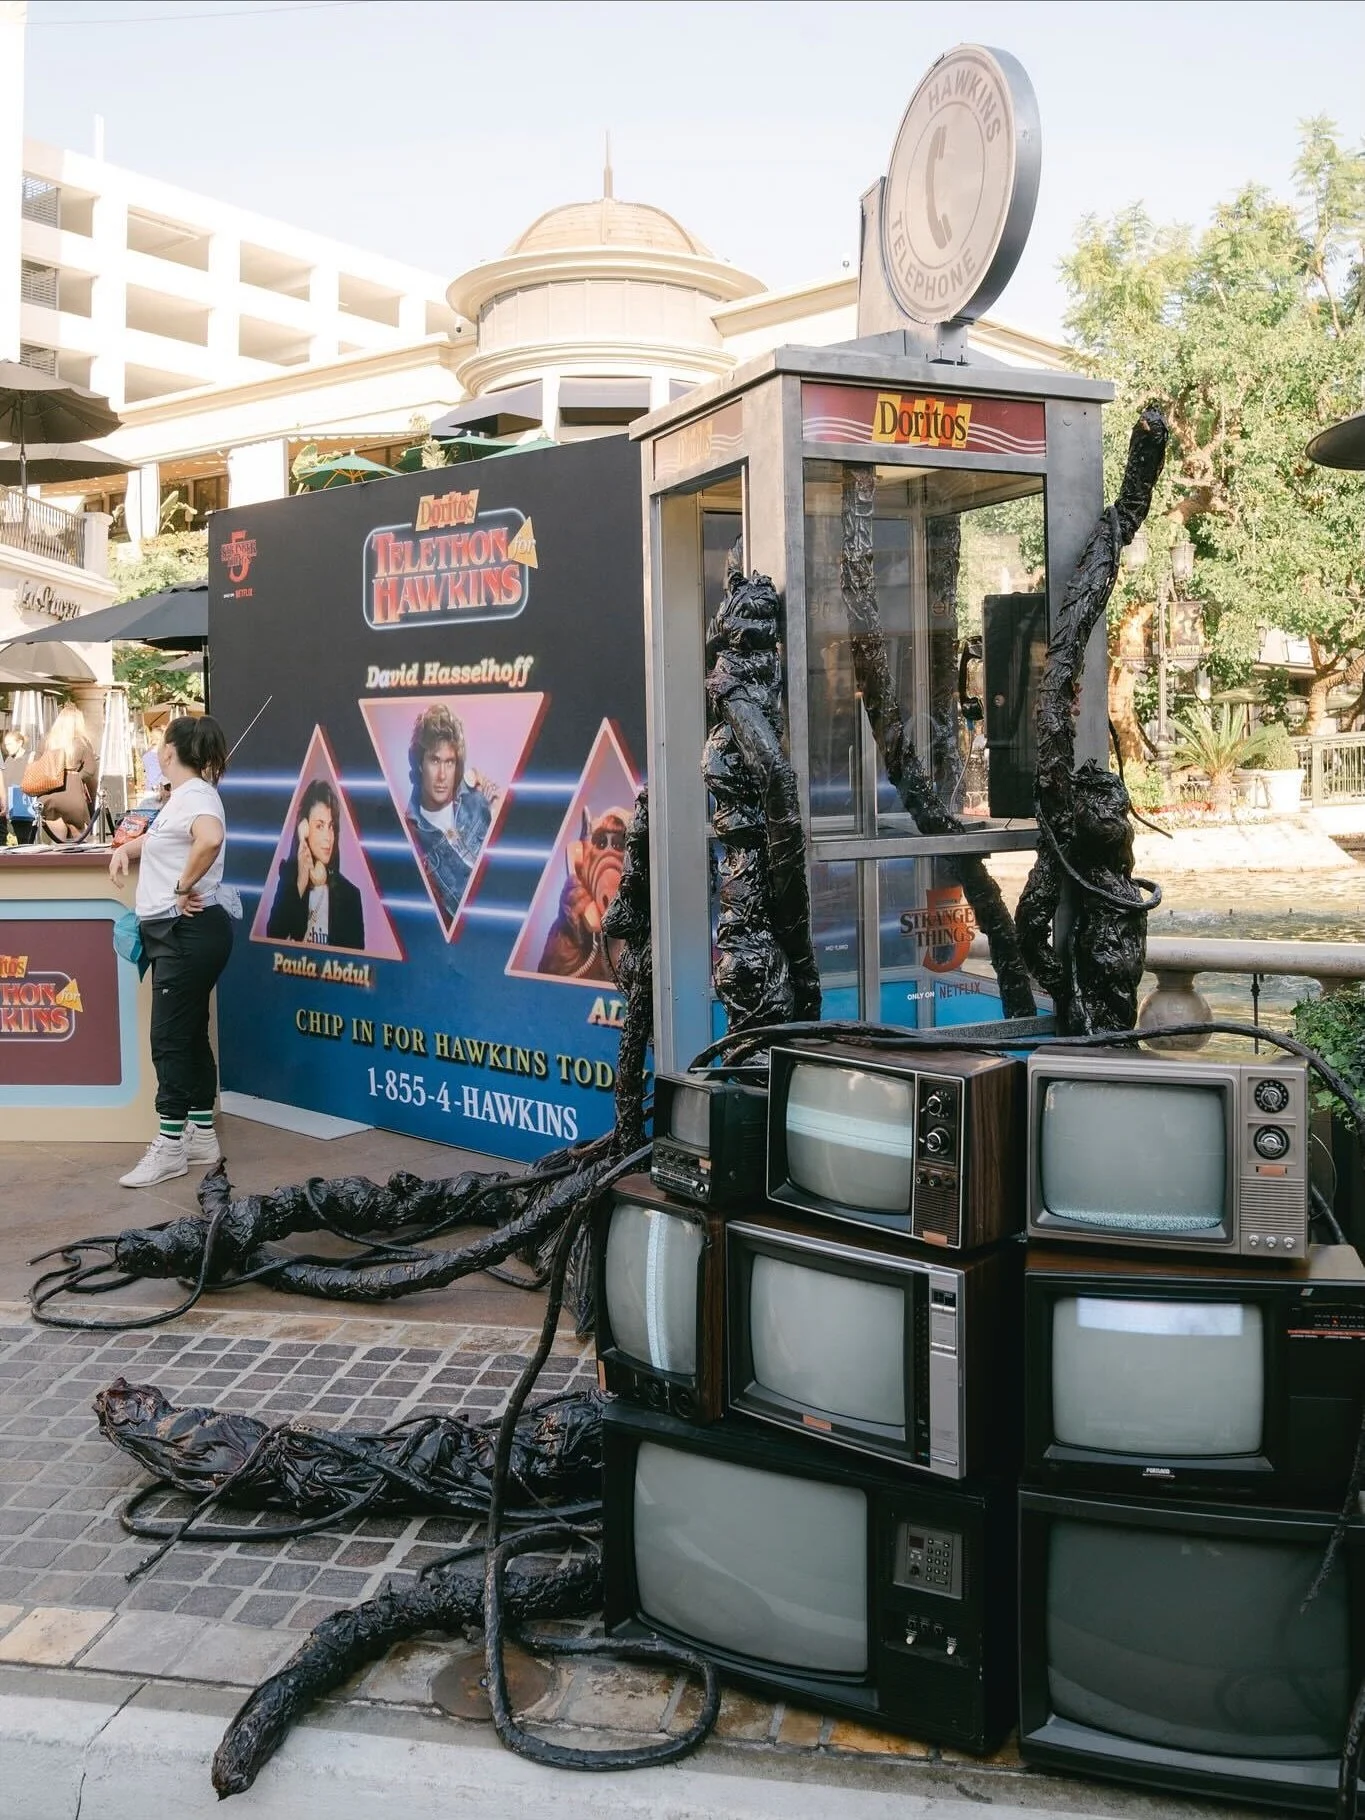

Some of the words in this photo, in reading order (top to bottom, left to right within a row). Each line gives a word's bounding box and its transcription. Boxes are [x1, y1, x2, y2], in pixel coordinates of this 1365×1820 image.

[928, 68, 1001, 143] HAWKINS
[890, 211, 976, 300] TELEPHONE
[879, 400, 967, 442] Doritos
[419, 494, 475, 526] Doritos
[372, 527, 509, 578] TELETHON
[512, 537, 537, 559] for
[372, 564, 522, 624] HAWKINS
[365, 661, 420, 689] David
[422, 654, 534, 689] Hasselhoff
[900, 907, 976, 935] STRANGE
[917, 925, 976, 948] THINGS
[273, 952, 317, 978] Paula
[321, 959, 371, 988] Abdul
[0, 983, 57, 1006] HON
[907, 992, 924, 1000] ONLY
[925, 991, 935, 999] ON
[940, 981, 981, 1000] NETFLIX
[0, 1006, 70, 1033] KINS
[587, 996, 625, 1030] AL
[296, 1008, 343, 1037] CHIP
[352, 1018, 373, 1043] IN
[382, 1023, 426, 1053] FOR
[434, 1032, 547, 1076] HAWKINS
